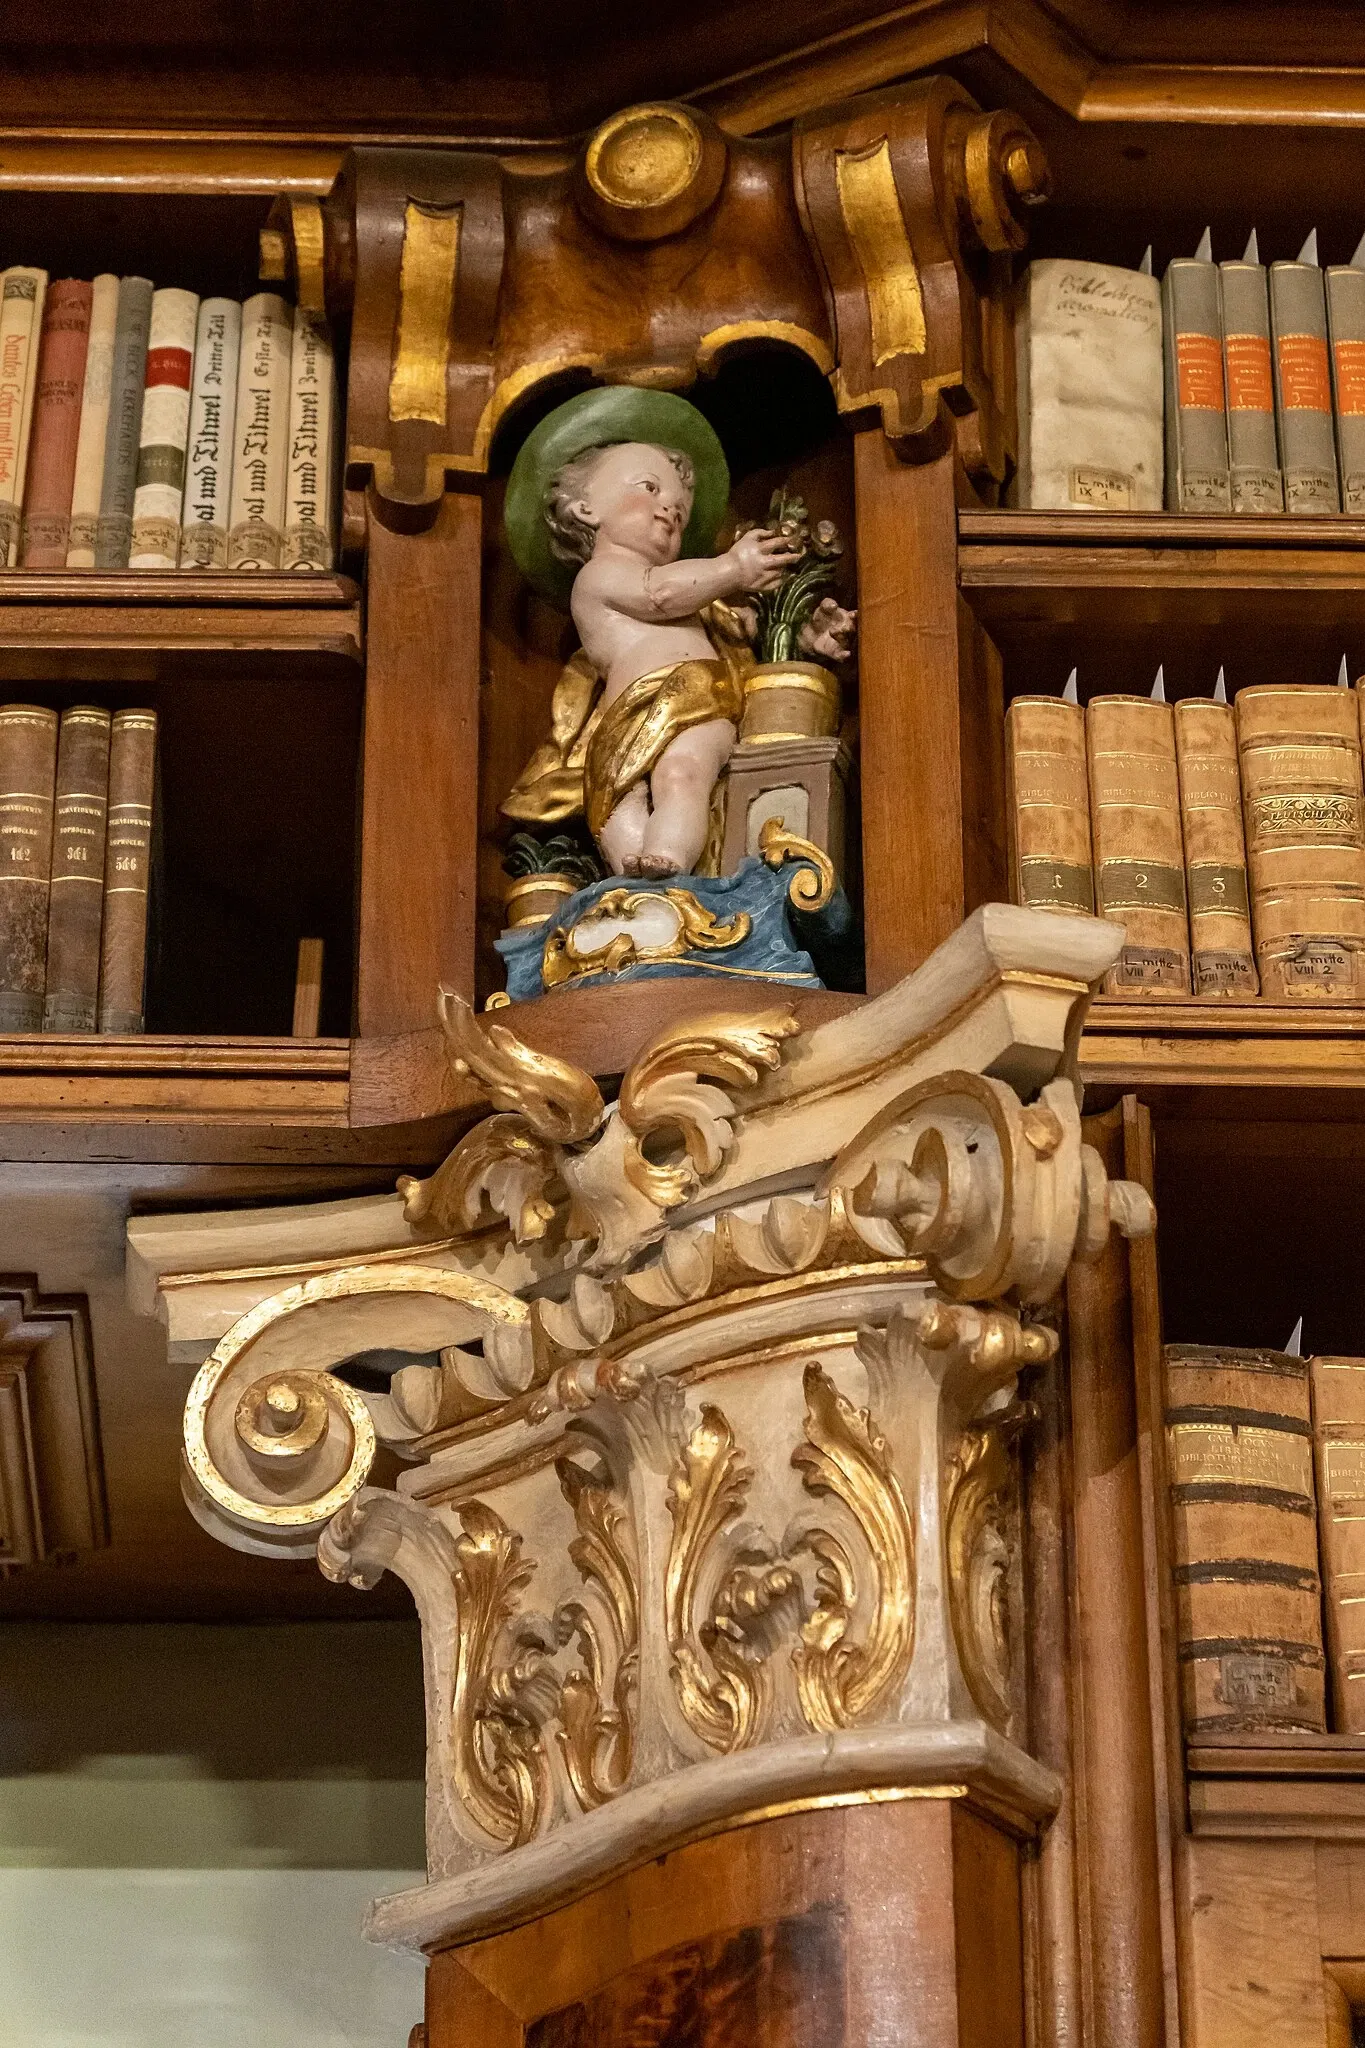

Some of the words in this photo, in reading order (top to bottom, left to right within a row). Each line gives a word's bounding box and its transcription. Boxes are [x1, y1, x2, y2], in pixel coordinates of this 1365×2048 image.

[206, 314, 225, 340] Teil
[203, 342, 223, 385] Dritter
[297, 341, 318, 384] Zweiter
[192, 394, 222, 462] Titurel
[243, 388, 271, 455] Titurel
[292, 391, 319, 458] Titurel
[194, 466, 218, 498] und
[245, 459, 267, 491] und
[293, 462, 317, 494] und
[1077, 475, 1088, 485] L
[1093, 481, 1122, 492] mitte
[1197, 478, 1226, 489] mitte
[1245, 477, 1276, 490] mitte
[1286, 479, 1297, 488] L
[1301, 477, 1330, 489] mitte
[1080, 487, 1092, 496] IX
[1101, 490, 1108, 500] 1
[1184, 488, 1196, 497] IX
[1205, 487, 1215, 497] 2
[1253, 487, 1264, 497] 2
[1288, 489, 1300, 498] IX
[1309, 487, 1320, 497] 2
[1134, 873, 1148, 888] 2
[1211, 877, 1226, 893] 3
[1125, 955, 1137, 966] L
[1142, 956, 1175, 969] mitte
[1310, 953, 1345, 964] mitte
[1125, 967, 1144, 977] VIII
[1153, 968, 1161, 977] 1
[1199, 961, 1211, 973] L
[1215, 960, 1248, 972] mitte
[1295, 966, 1315, 975] VIII
[1322, 965, 1334, 975] 2
[1200, 973, 1218, 983] VIII
[1227, 971, 1235, 981] 1
